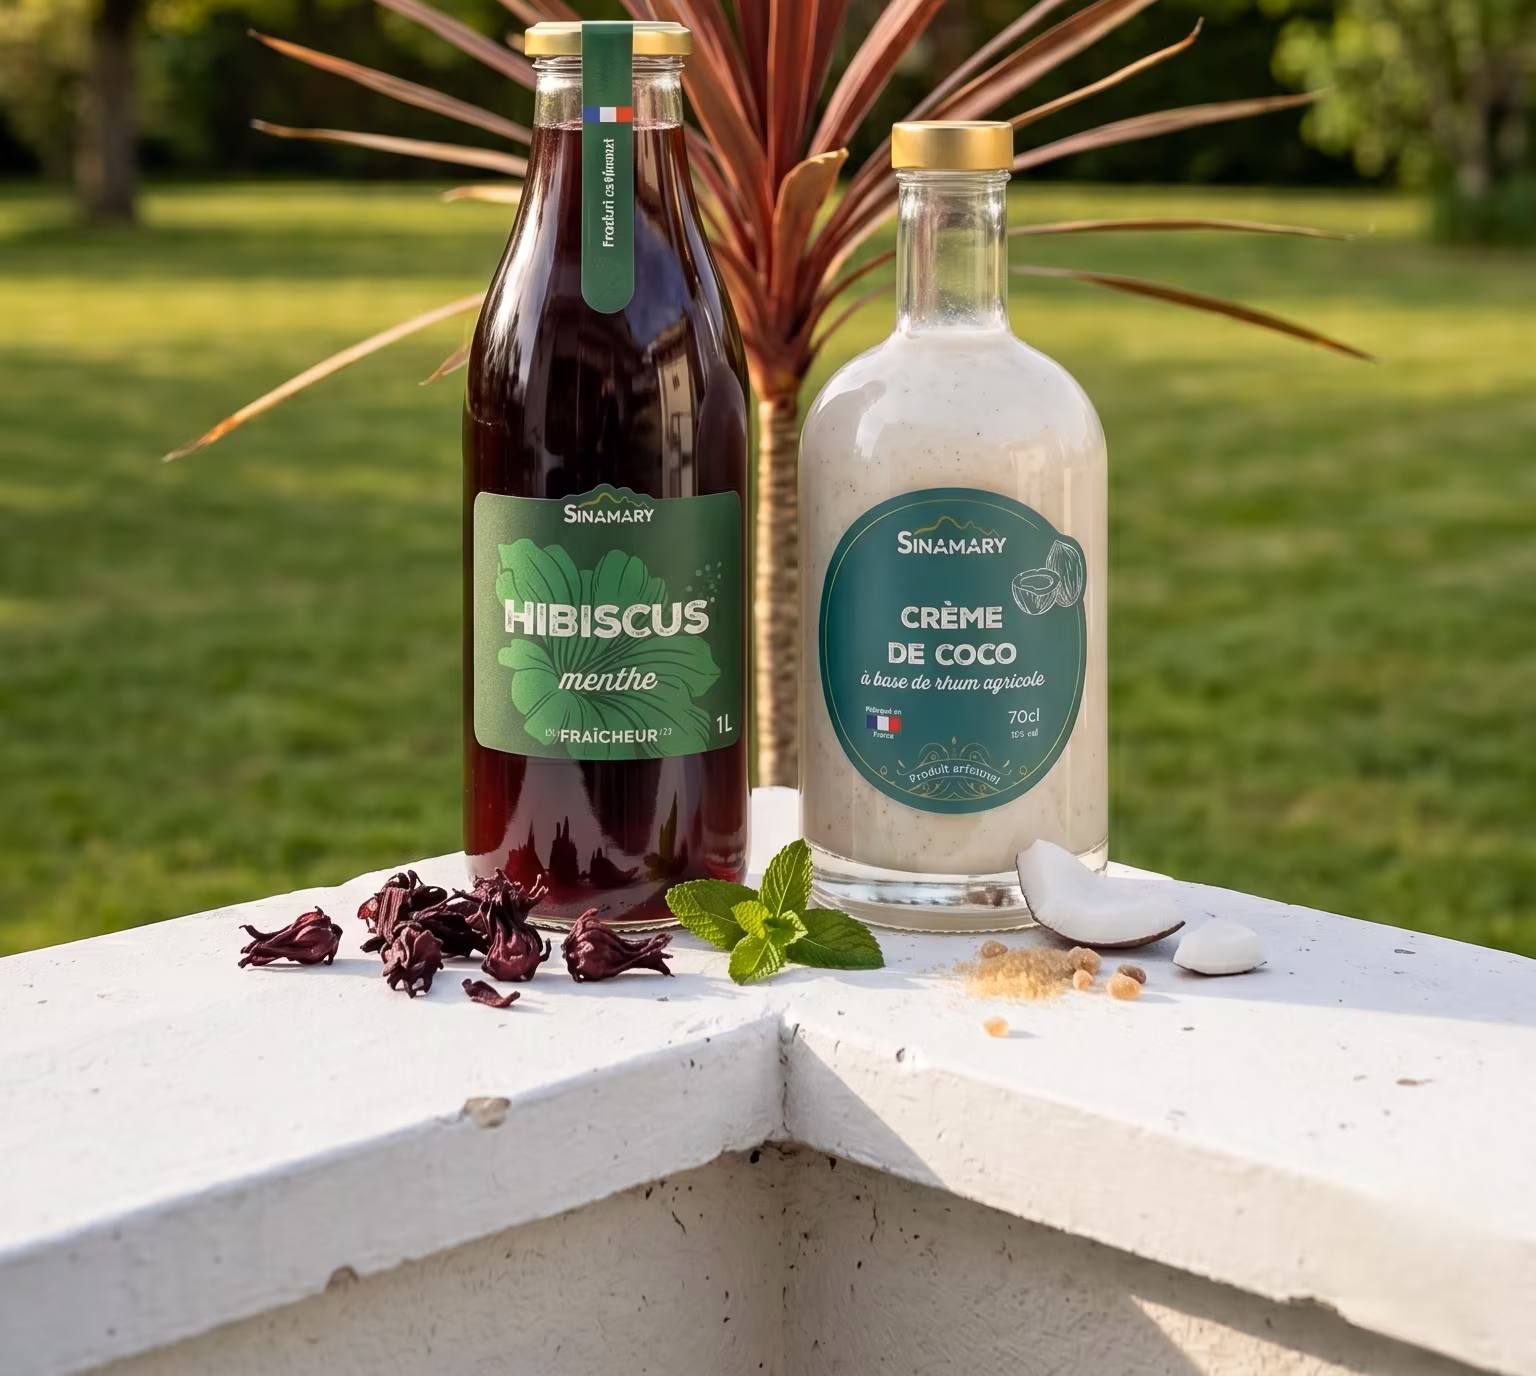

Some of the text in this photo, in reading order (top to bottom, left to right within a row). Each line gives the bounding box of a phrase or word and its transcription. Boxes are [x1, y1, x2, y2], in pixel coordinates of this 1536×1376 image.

[504, 598, 710, 639] HIBISCUS
[900, 600, 1003, 630] CRÈME
[888, 641, 1018, 666] DE COCO
[558, 666, 659, 692] menthe
[860, 670, 1046, 695] à base de rhum agricole
[716, 713, 733, 734] 1L
[1008, 707, 1040, 724] 70cl
[908, 764, 950, 783] Produit
